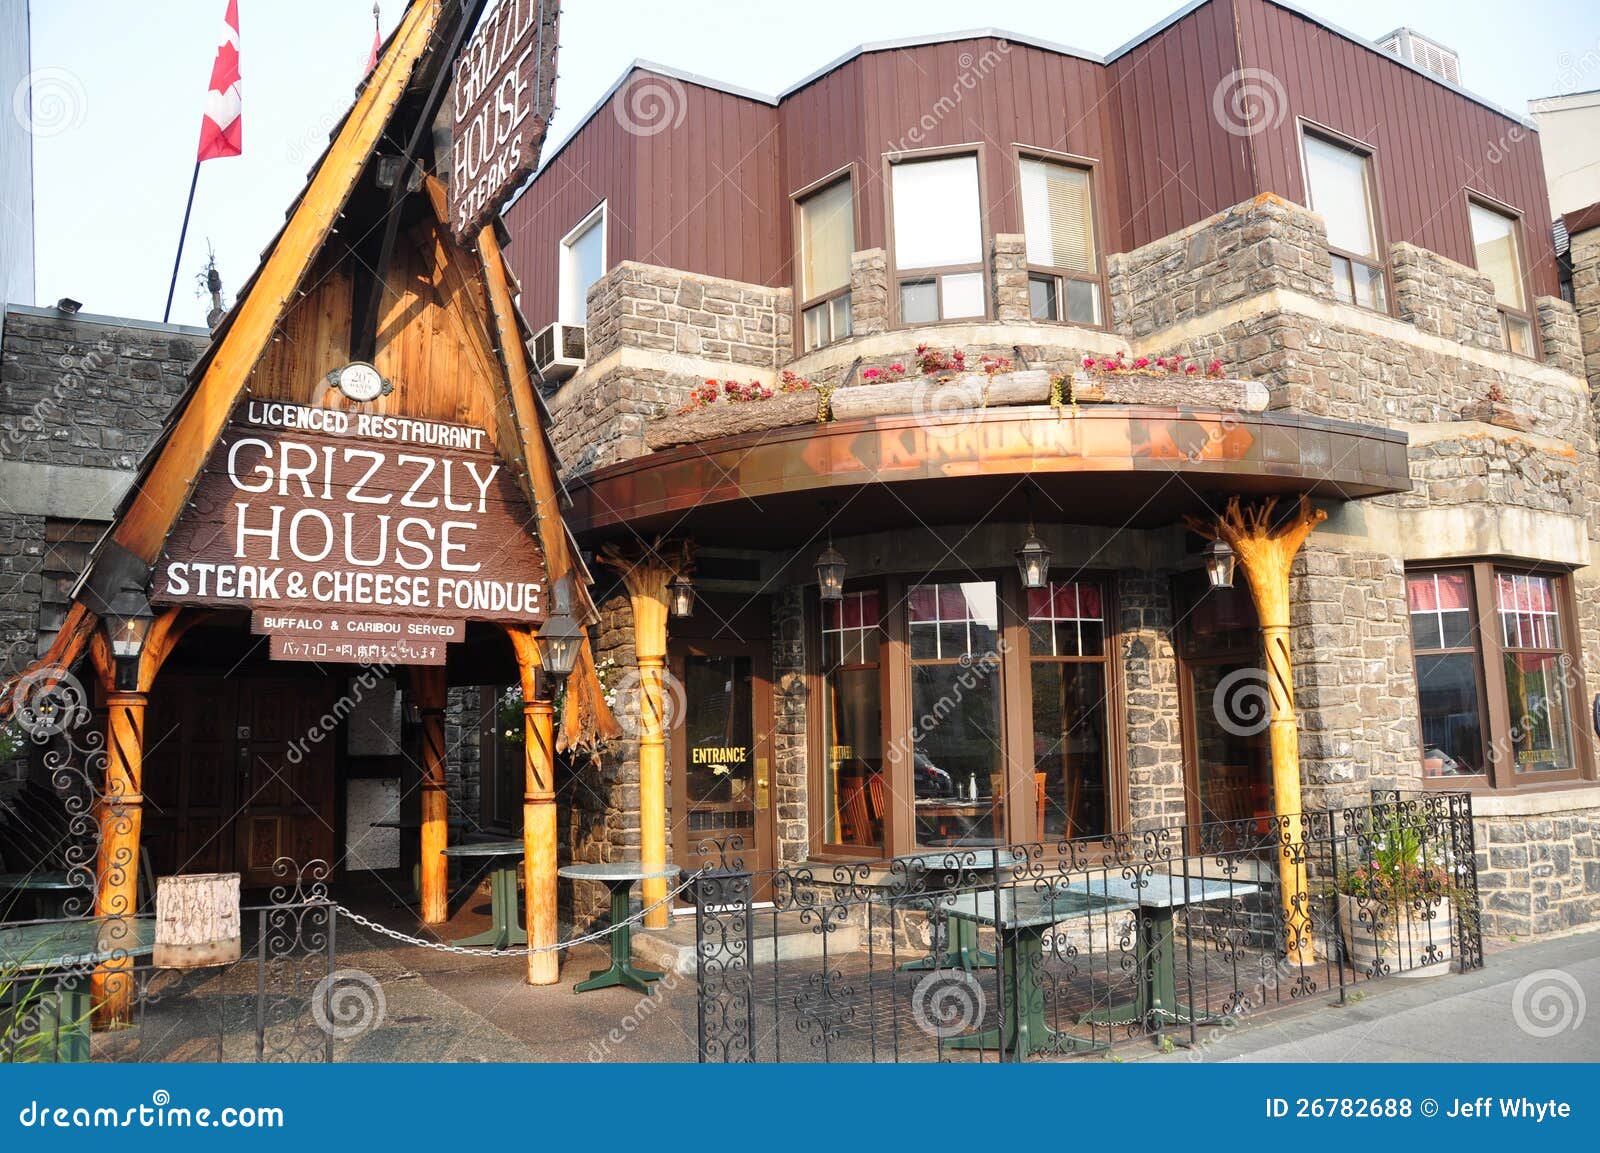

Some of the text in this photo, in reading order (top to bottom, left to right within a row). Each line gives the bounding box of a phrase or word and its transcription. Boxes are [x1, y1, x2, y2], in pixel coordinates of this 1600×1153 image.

[454, 42, 533, 202] HOUSE
[458, 132, 522, 232] STEAKS
[248, 401, 486, 450] LICENCED RESTAURANT
[227, 438, 500, 513] GRIZZLY
[234, 503, 481, 572] HOUSE
[166, 562, 541, 614] STEAK & CHEESE FONDUE
[263, 617, 455, 636] BUFFALO & CARIBOU SERVED
[692, 747, 746, 764] ENTRANCE
